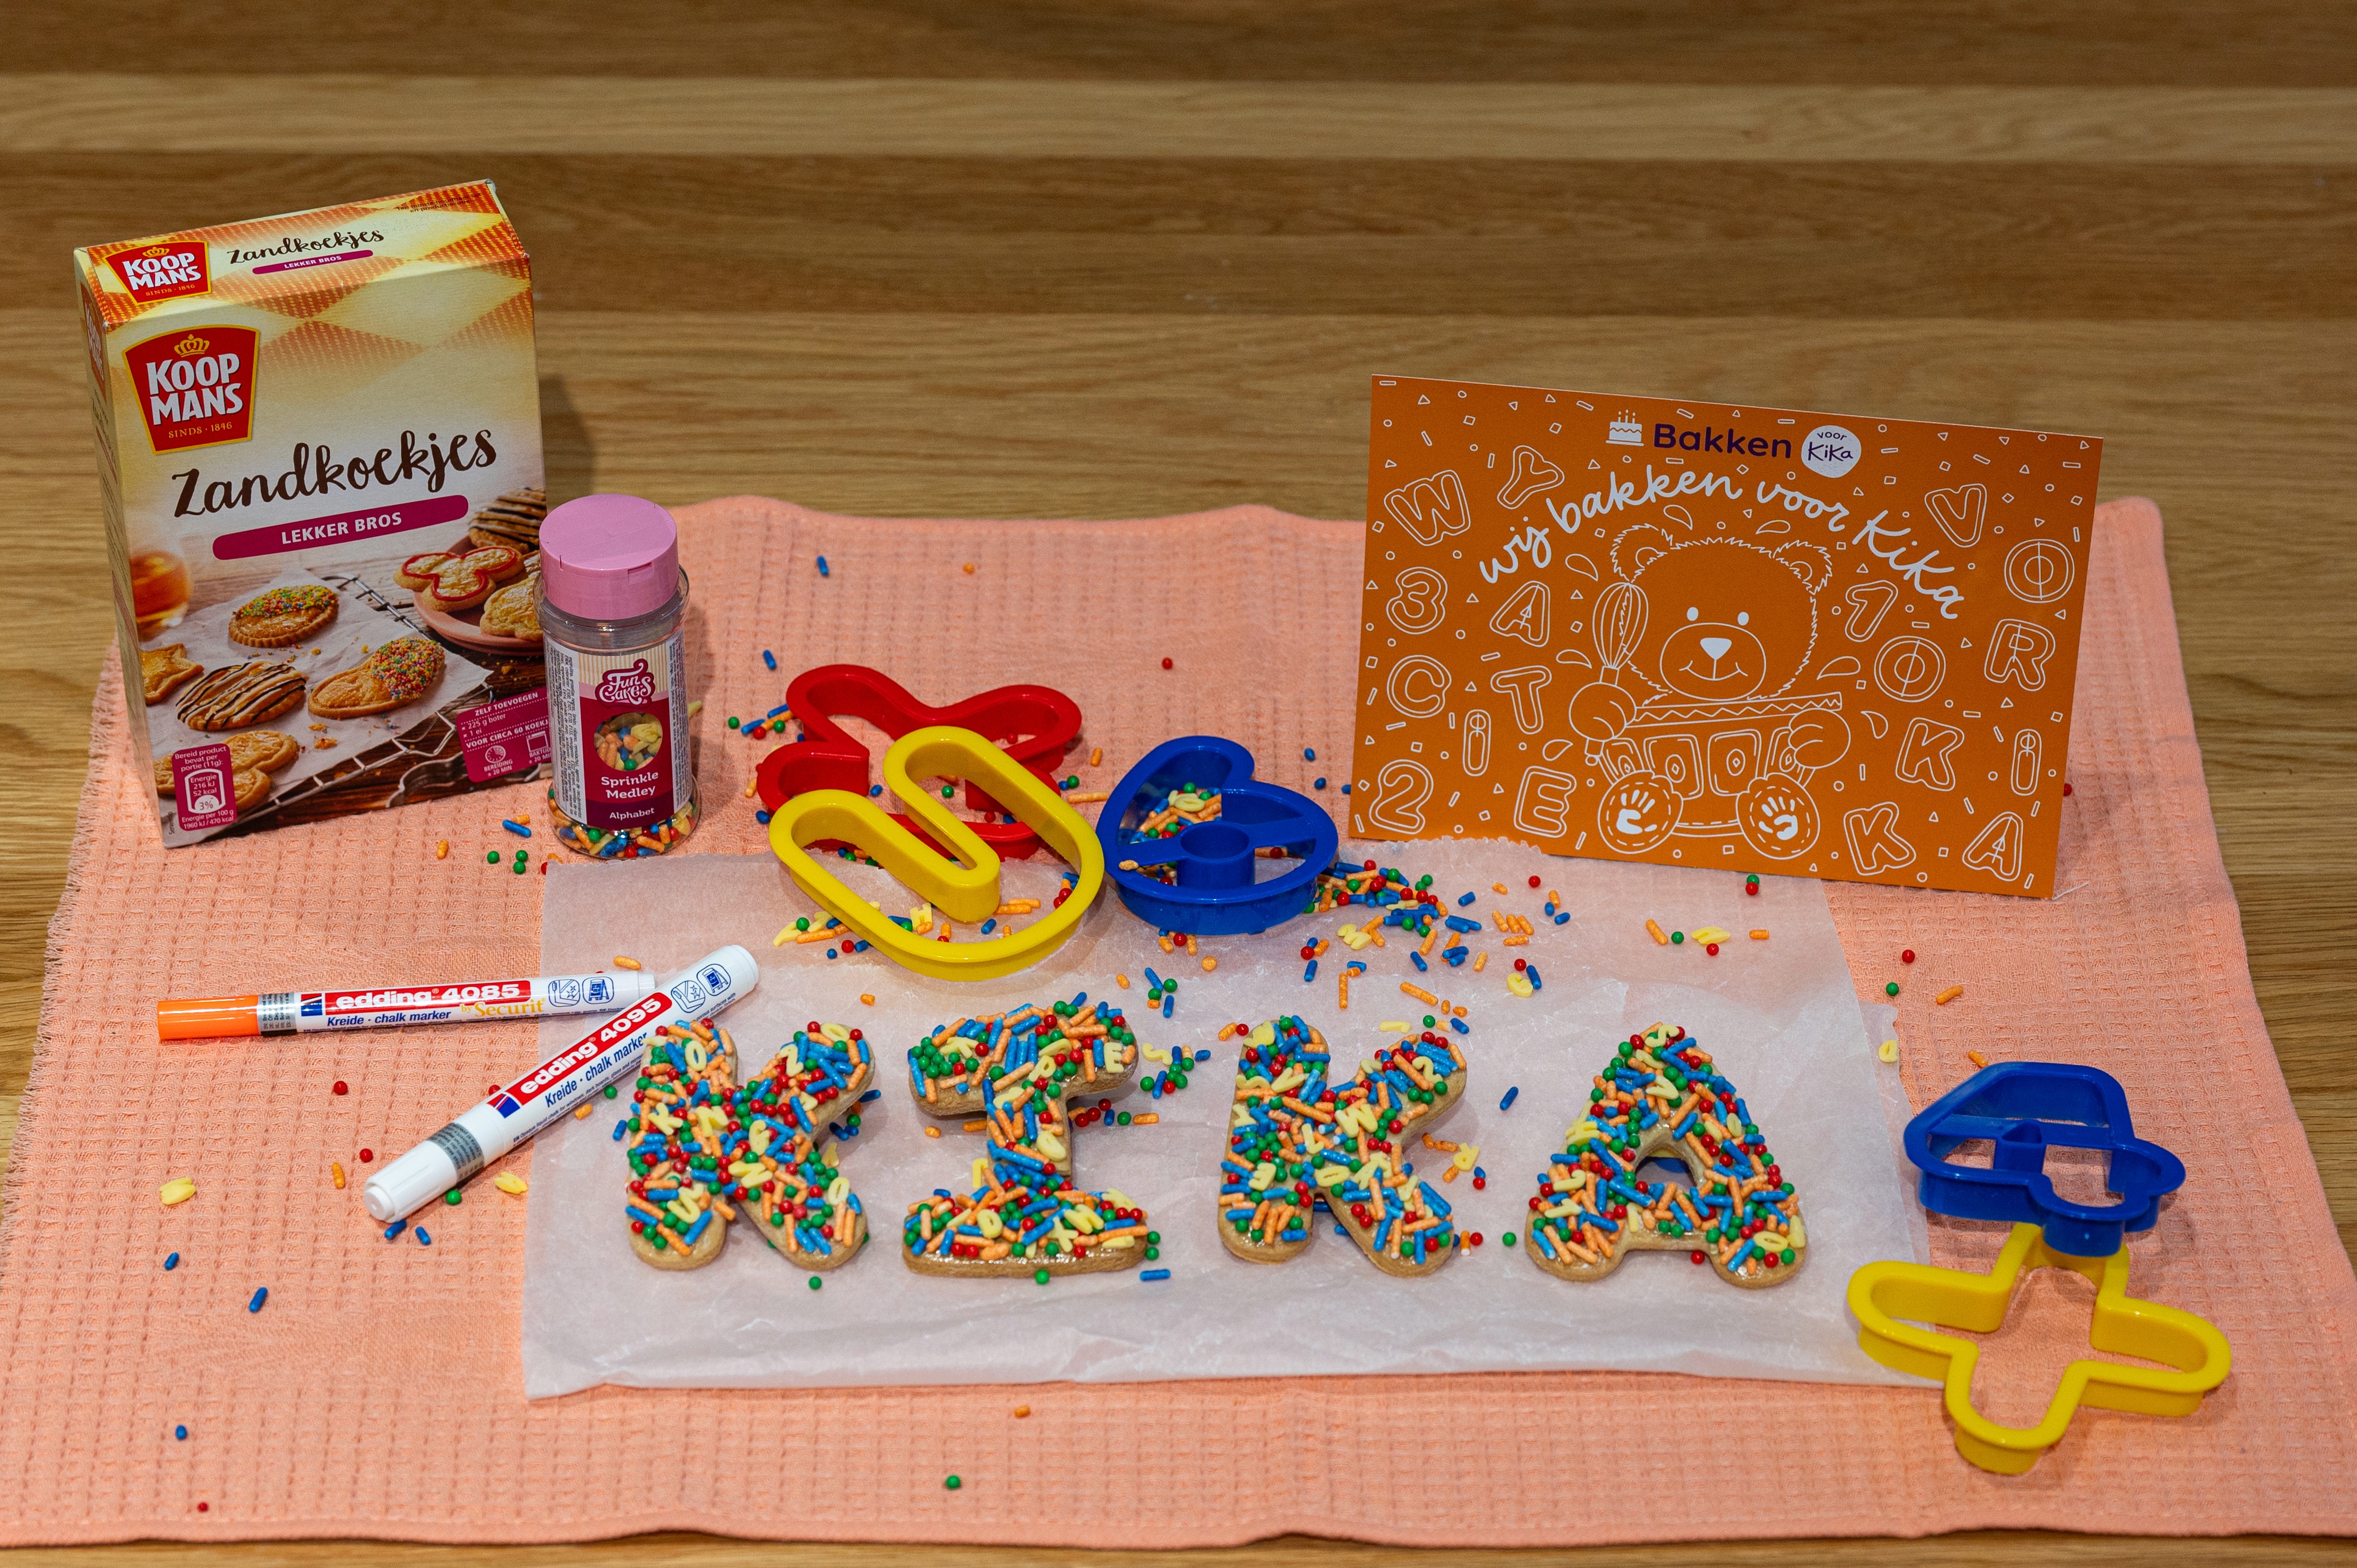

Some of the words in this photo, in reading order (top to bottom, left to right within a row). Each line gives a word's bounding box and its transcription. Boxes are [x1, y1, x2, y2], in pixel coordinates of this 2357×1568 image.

[226, 230, 384, 264] Zandkoekjes
[122, 252, 195, 277] KOOP
[284, 259, 317, 269] LEKKER
[128, 265, 202, 291] MANS
[145, 288, 172, 296] SINDS
[146, 353, 239, 395] KOOP
[150, 383, 243, 425] MANS
[168, 426, 202, 438] SINDS
[211, 422, 233, 432] 1846
[1816, 431, 1847, 441] voor
[1653, 423, 1792, 459] Bakken
[172, 429, 497, 518] Zandkoekjes
[1384, 469, 1471, 546] W
[281, 522, 349, 545] LEKKER
[355, 512, 402, 531] BROS
[1479, 516, 1551, 585] wij
[1546, 464, 1743, 534] bakken
[1756, 481, 1850, 532] voor
[1386, 567, 1448, 635] 3
[1386, 655, 1452, 718] C
[475, 706, 492, 716] ZELF
[493, 692, 538, 710] TOEVOEGEN
[1490, 665, 1552, 735] T
[468, 721, 481, 730] 225
[488, 713, 506, 723] boter
[466, 738, 488, 749] VOOR
[490, 731, 512, 742] CIRCA
[525, 719, 548, 731] KOEKJ
[175, 750, 198, 759] Bereid
[199, 746, 227, 756] product
[206, 754, 218, 762] per
[181, 763, 202, 773] portie
[484, 759, 513, 772] BEREIDING
[190, 774, 217, 783] Energie
[601, 772, 658, 788] Sprinkle
[605, 786, 656, 799] Medley
[1368, 759, 1434, 835] 2
[1513, 765, 1577, 838] E
[199, 801, 213, 810] 3%
[609, 807, 655, 820] Alphabet
[182, 814, 205, 822] Energie
[441, 983, 520, 1001] 4085
[327, 1014, 364, 1027] Kreide
[374, 1012, 405, 1024] chalk
[408, 1010, 452, 1022] marker
[460, 1004, 474, 1013] by
[600, 998, 662, 1042] 4095
[545, 1079, 577, 1108] Kreide
[585, 1056, 613, 1082] chalk
[614, 1031, 647, 1063] marker
[546, 1109, 559, 1119] chalk
